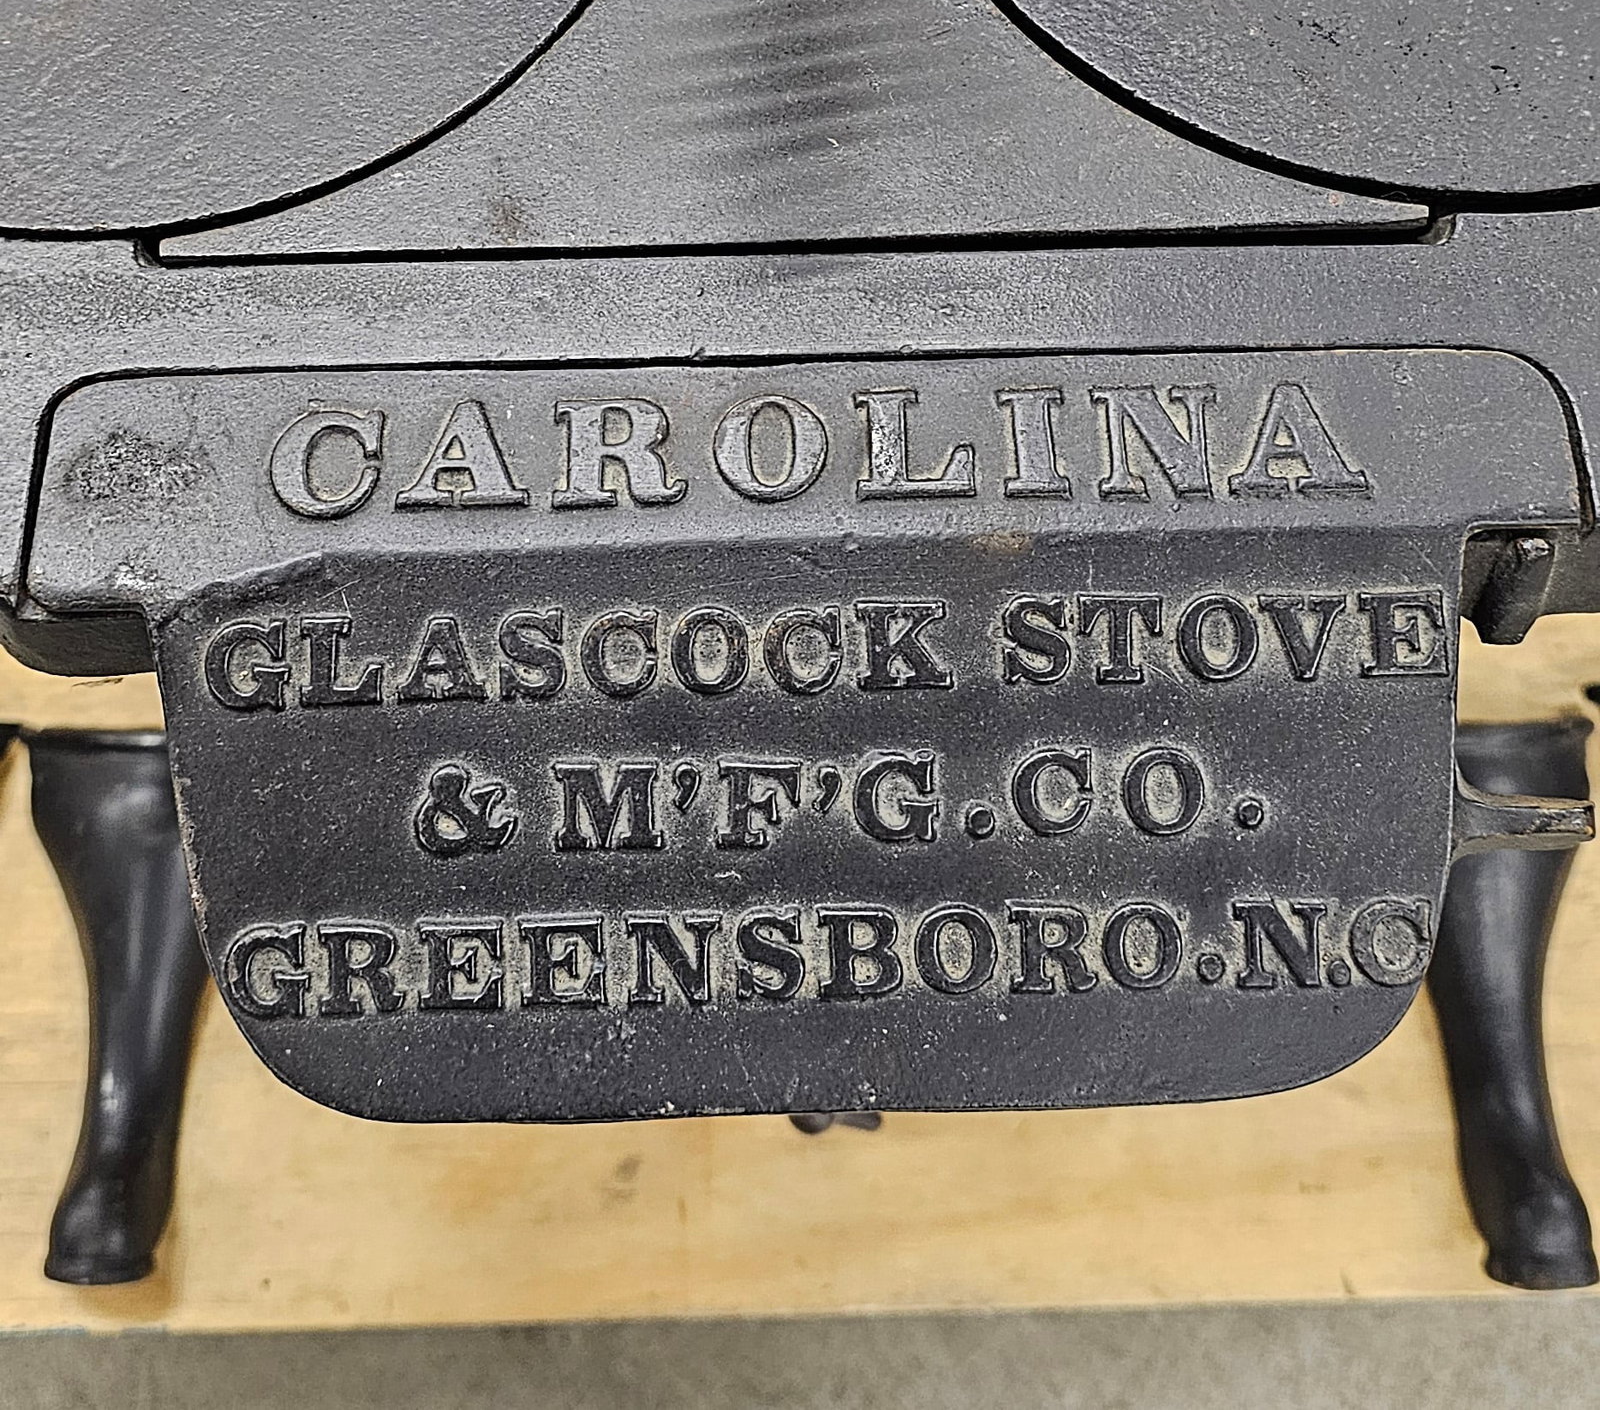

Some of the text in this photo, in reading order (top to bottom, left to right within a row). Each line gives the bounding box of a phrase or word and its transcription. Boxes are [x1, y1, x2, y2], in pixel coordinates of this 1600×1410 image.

[269, 381, 1372, 520] CAROLINA
[203, 590, 1450, 711] GLASCOCK STOVE
[413, 762, 518, 855] &
